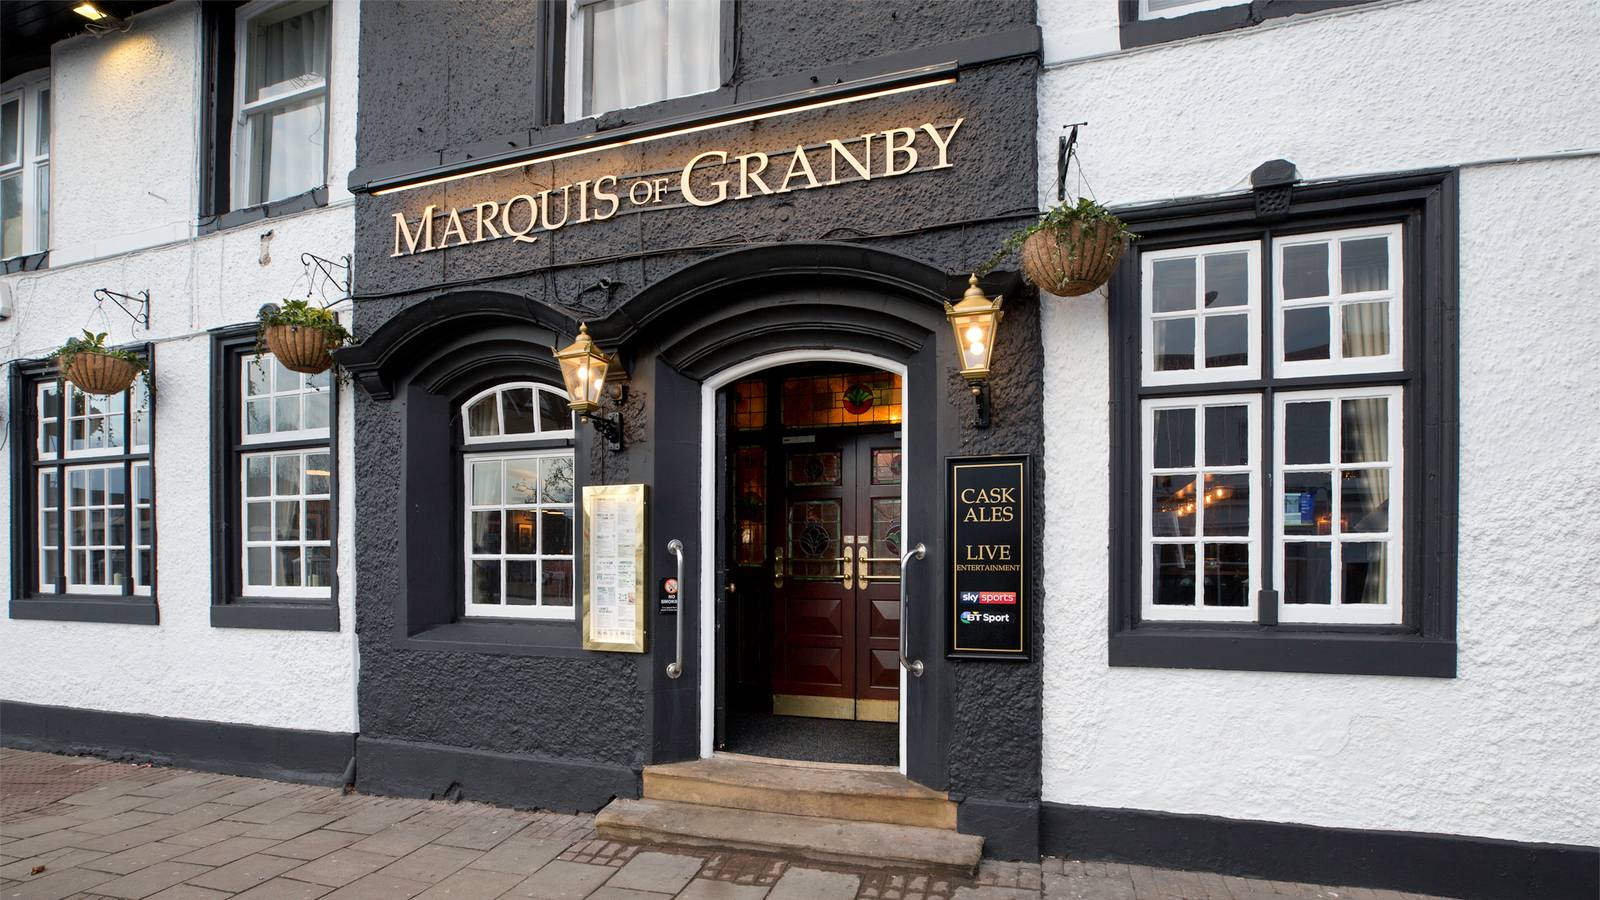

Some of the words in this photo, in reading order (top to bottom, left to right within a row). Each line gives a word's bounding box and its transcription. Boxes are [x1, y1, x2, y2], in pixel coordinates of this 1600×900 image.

[390, 174, 621, 258] MARQUIS
[629, 179, 669, 206] OF
[680, 118, 965, 207] GRANBY
[960, 487, 1016, 504] CASK
[963, 506, 1014, 523] ALES
[965, 544, 1012, 561] LIVE
[956, 564, 1021, 572] ENTERTAINMENT
[962, 592, 979, 603] sky
[981, 593, 1014, 603] sports
[982, 613, 1010, 624] Sport
